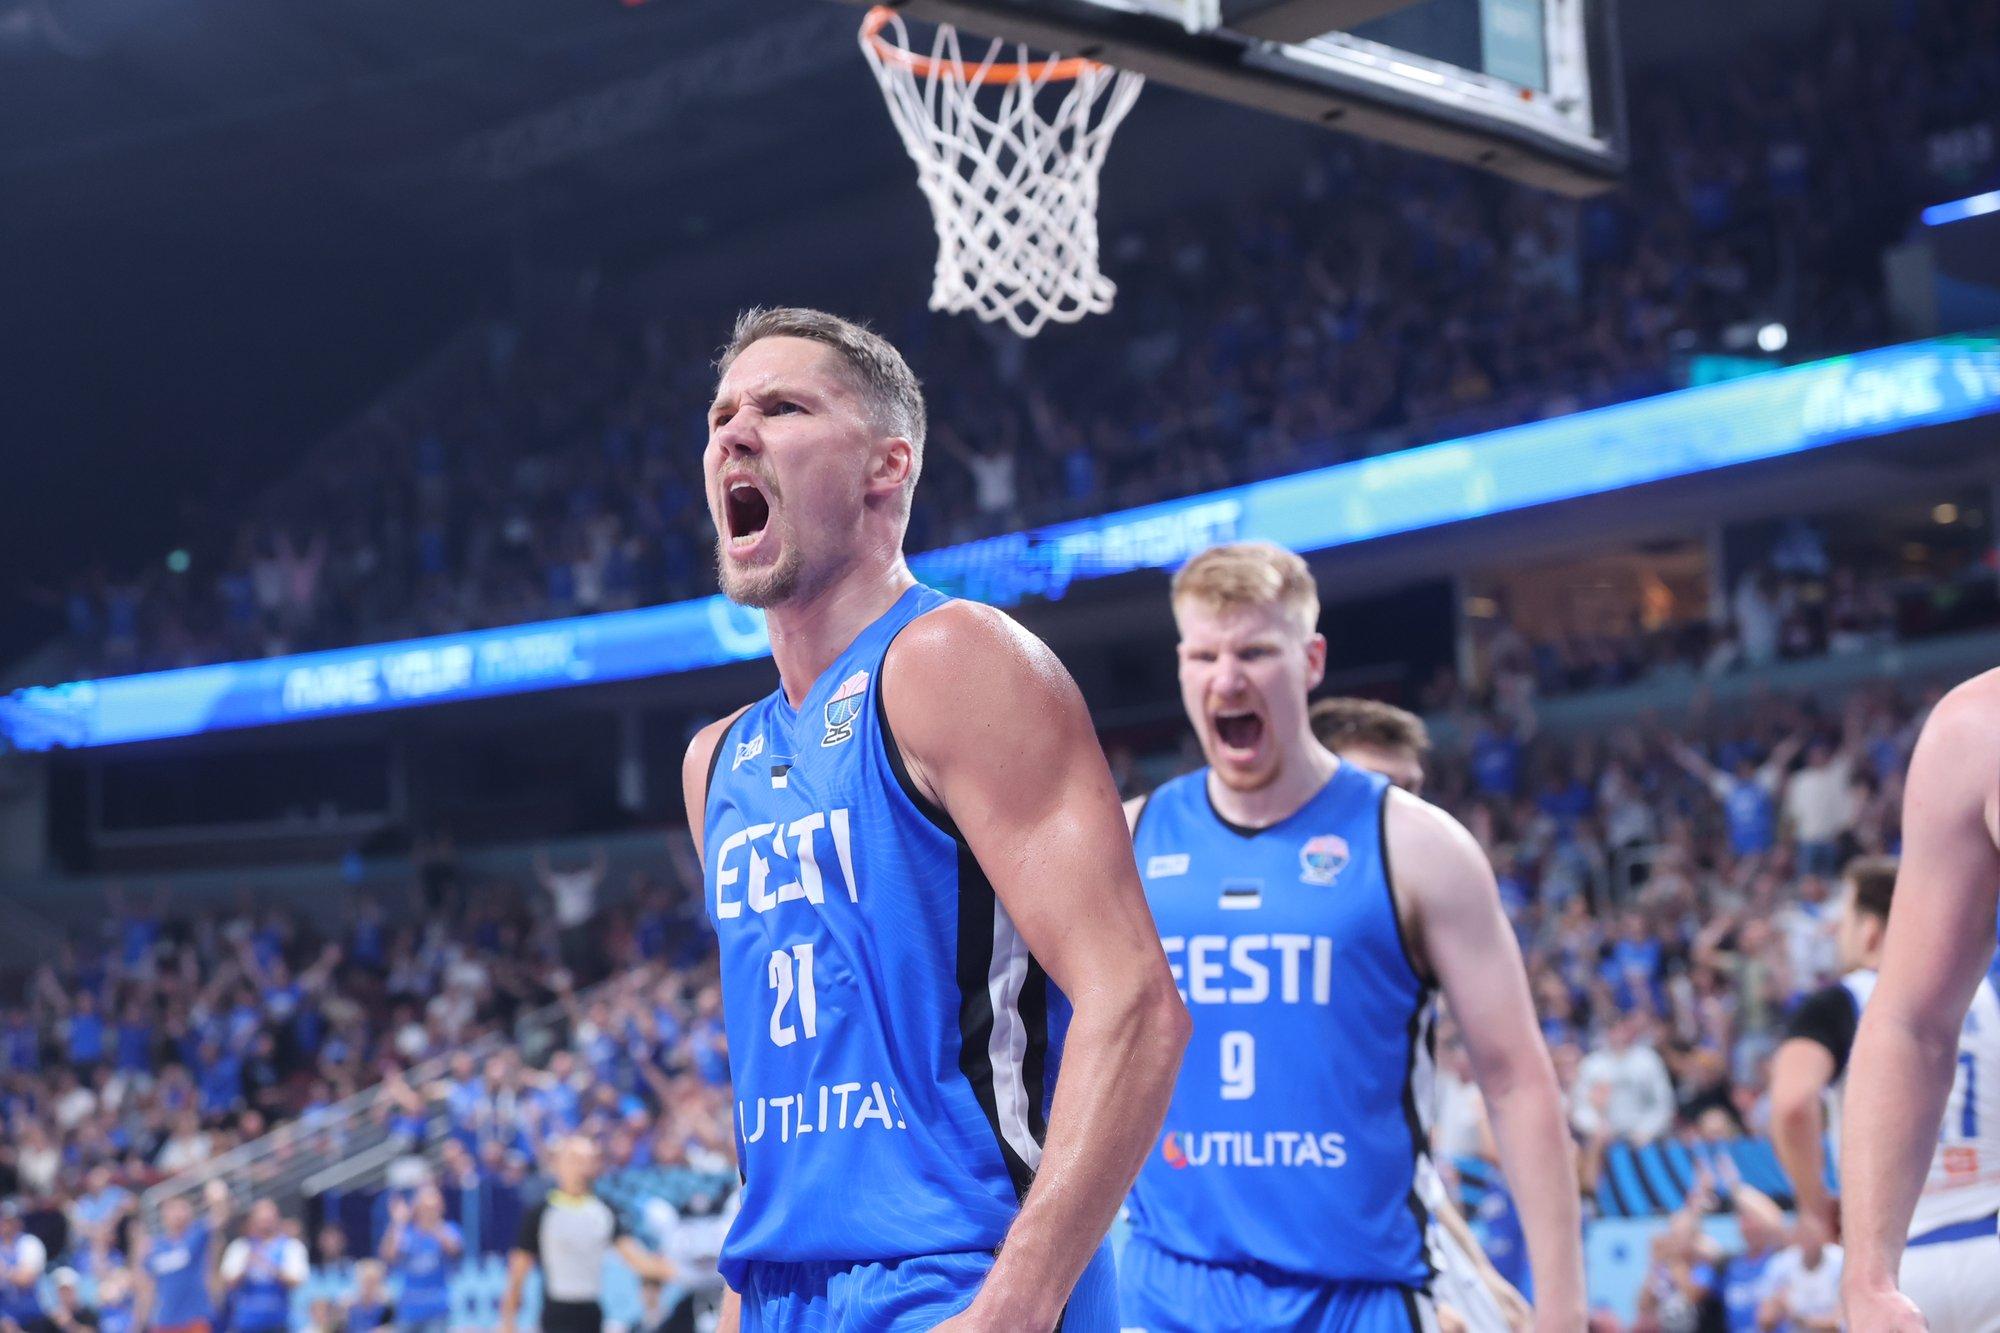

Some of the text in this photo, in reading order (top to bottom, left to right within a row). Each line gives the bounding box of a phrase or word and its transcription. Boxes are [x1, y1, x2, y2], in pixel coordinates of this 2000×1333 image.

[823, 723, 851, 745] 25
[768, 943, 817, 1048] 21
[1220, 1030, 1256, 1101] 9
[1184, 1131, 1348, 1168] UTILITAS
